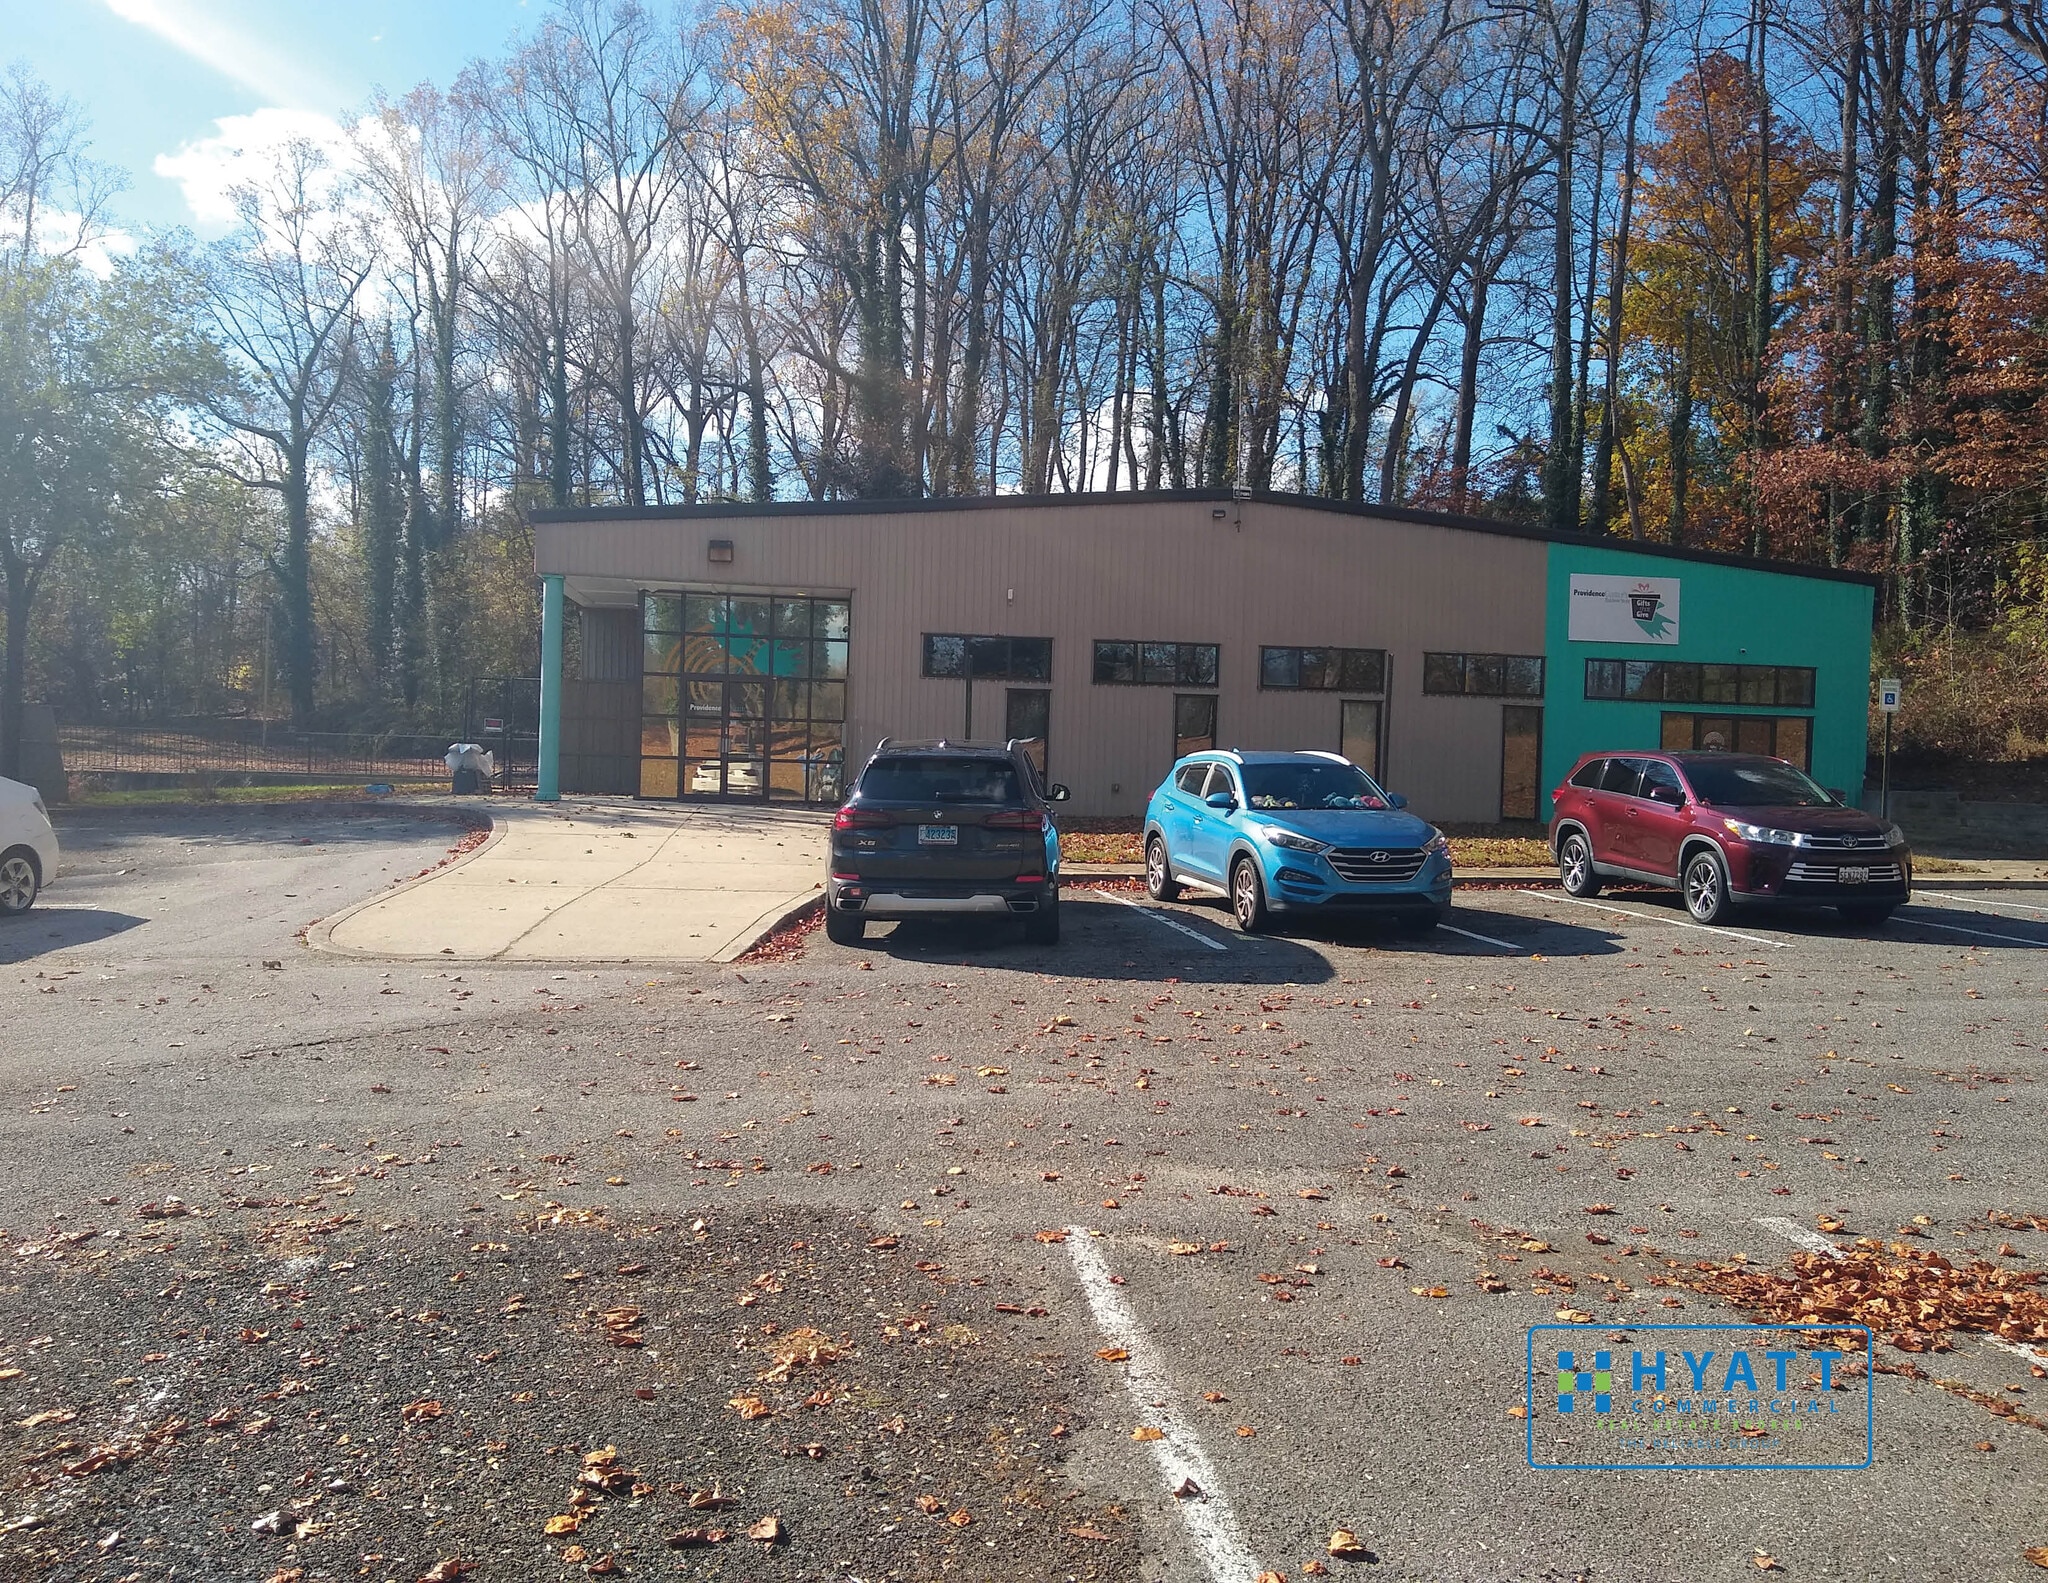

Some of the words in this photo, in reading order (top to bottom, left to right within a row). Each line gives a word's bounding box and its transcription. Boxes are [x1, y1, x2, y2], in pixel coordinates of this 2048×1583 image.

[1573, 588, 1605, 597] Providence
[1636, 610, 1649, 618] Give
[689, 703, 722, 712] Providence
